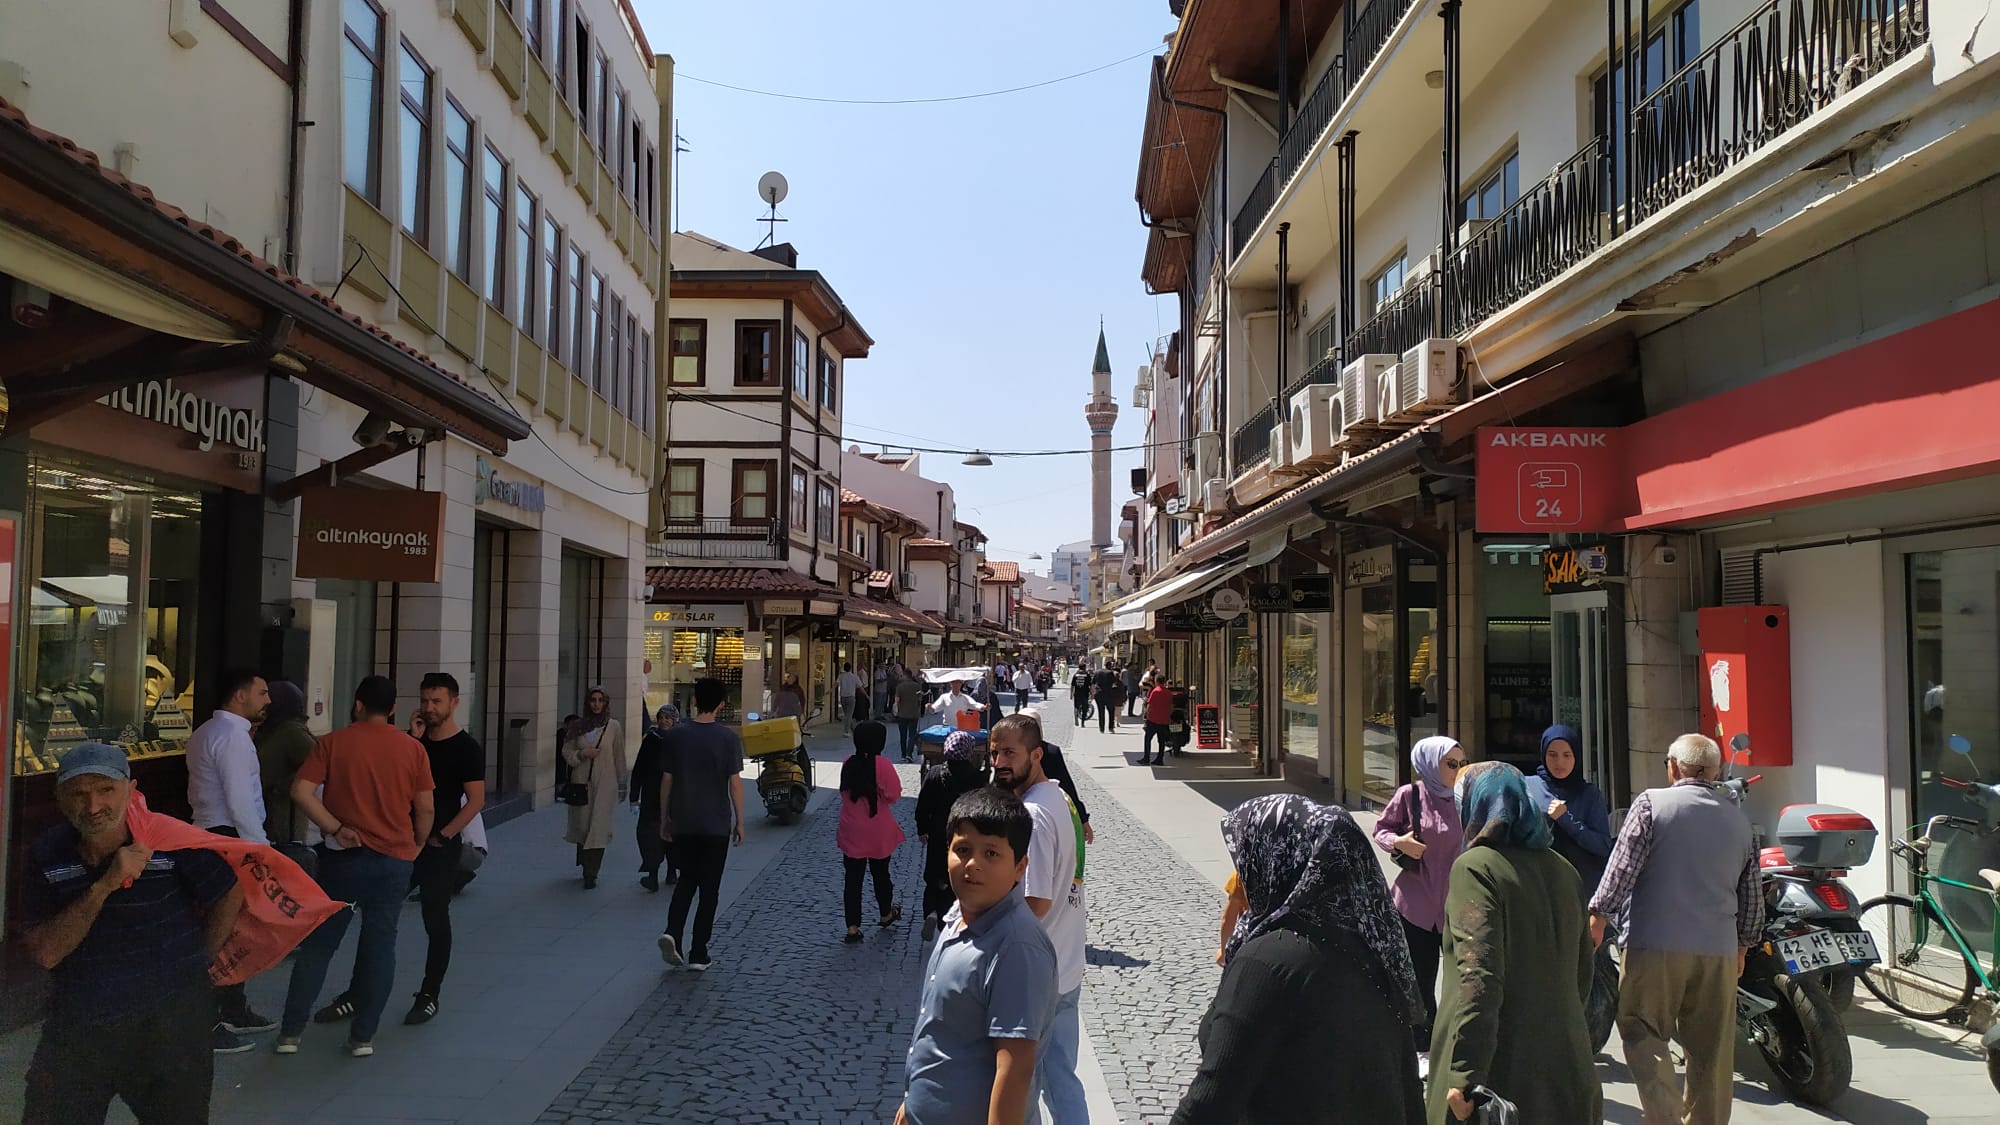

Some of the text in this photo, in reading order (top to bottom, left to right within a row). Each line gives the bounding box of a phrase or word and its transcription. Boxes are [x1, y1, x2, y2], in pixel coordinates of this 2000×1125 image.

[1490, 432, 1607, 447] AKBANK
[1536, 499, 1562, 517] 24
[403, 546, 427, 555] 1983
[1783, 932, 1832, 956] 42 HE
[1799, 950, 1830, 969] 646
